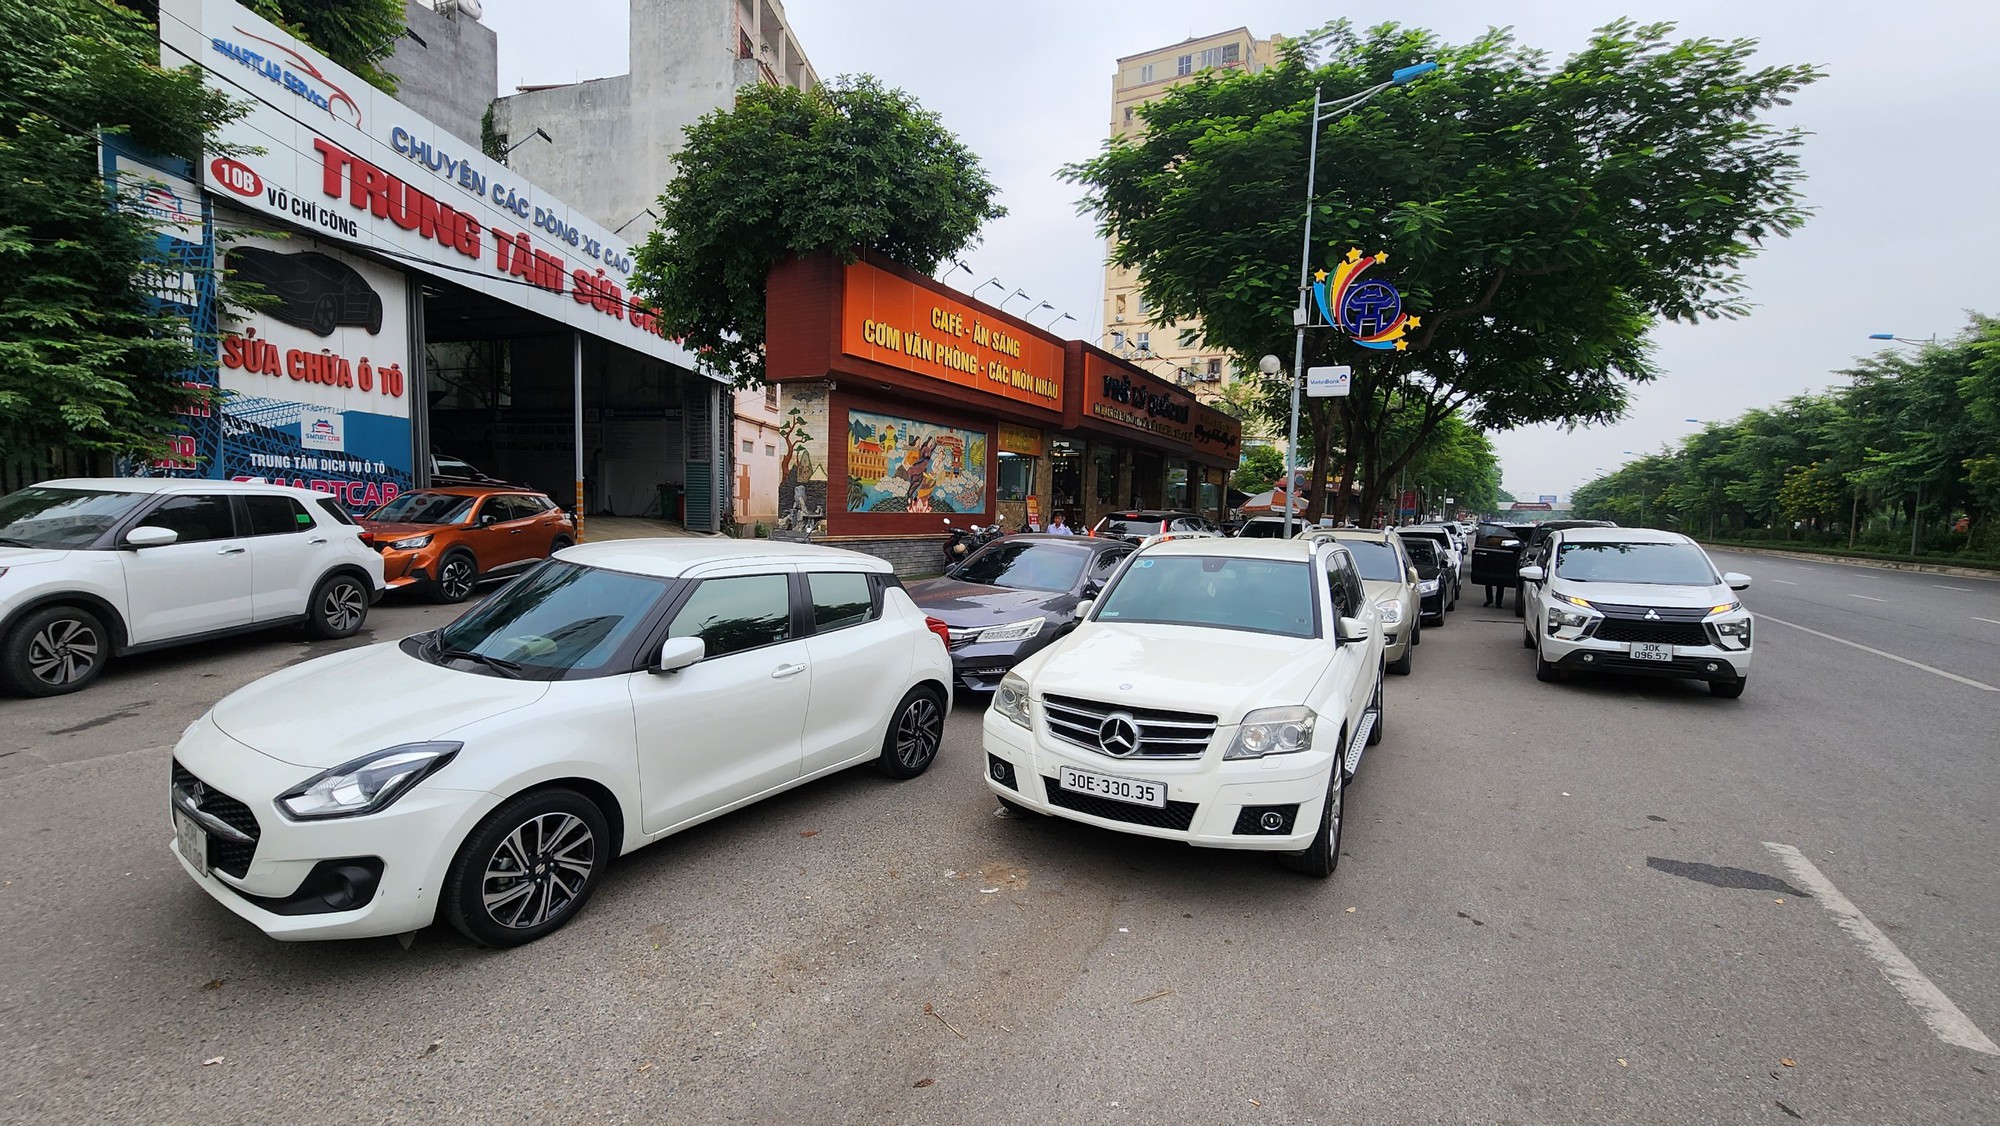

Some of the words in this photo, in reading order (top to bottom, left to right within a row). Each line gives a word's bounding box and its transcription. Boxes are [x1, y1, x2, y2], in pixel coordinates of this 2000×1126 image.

[283, 70, 329, 111] SERVICE
[221, 162, 254, 192] 10B
[267, 188, 287, 211] VÕ
[292, 197, 317, 222] CHÍ
[319, 209, 357, 238] CÔNG
[391, 126, 486, 196] CHUYÊN
[492, 187, 530, 219] CÁC
[533, 207, 579, 247] DÒNG
[581, 234, 601, 260] XE
[603, 248, 630, 274] CAO
[313, 137, 481, 260] TRUNG
[492, 228, 564, 295] TÂM
[572, 268, 623, 320] SỬA
[931, 306, 962, 337] CAFÉ
[973, 320, 989, 347] ĂN
[991, 331, 1020, 358] SÁNG
[222, 327, 282, 377] SỬA
[286, 348, 353, 388] CHỮA
[358, 356, 373, 392] Ô
[378, 363, 404, 397] TÔ
[863, 319, 900, 351] CƠM
[903, 331, 932, 361] VĂN
[935, 343, 977, 375] PHÒNG
[988, 359, 1009, 384] CÁC
[1010, 368, 1033, 392] MÓN
[1034, 374, 1059, 400] NHẬU
[305, 433, 327, 441] SMART
[250, 454, 290, 469] TRUNG
[293, 455, 317, 470] TÂM
[321, 458, 345, 474] DỊCH
[348, 460, 362, 475] VỤ
[364, 460, 371, 474] Ô
[372, 460, 385, 474] TÔ
[1634, 651, 1668, 660] 096.57
[1642, 643, 1660, 651] 30K
[1068, 772, 1155, 801] 30E-330.35
